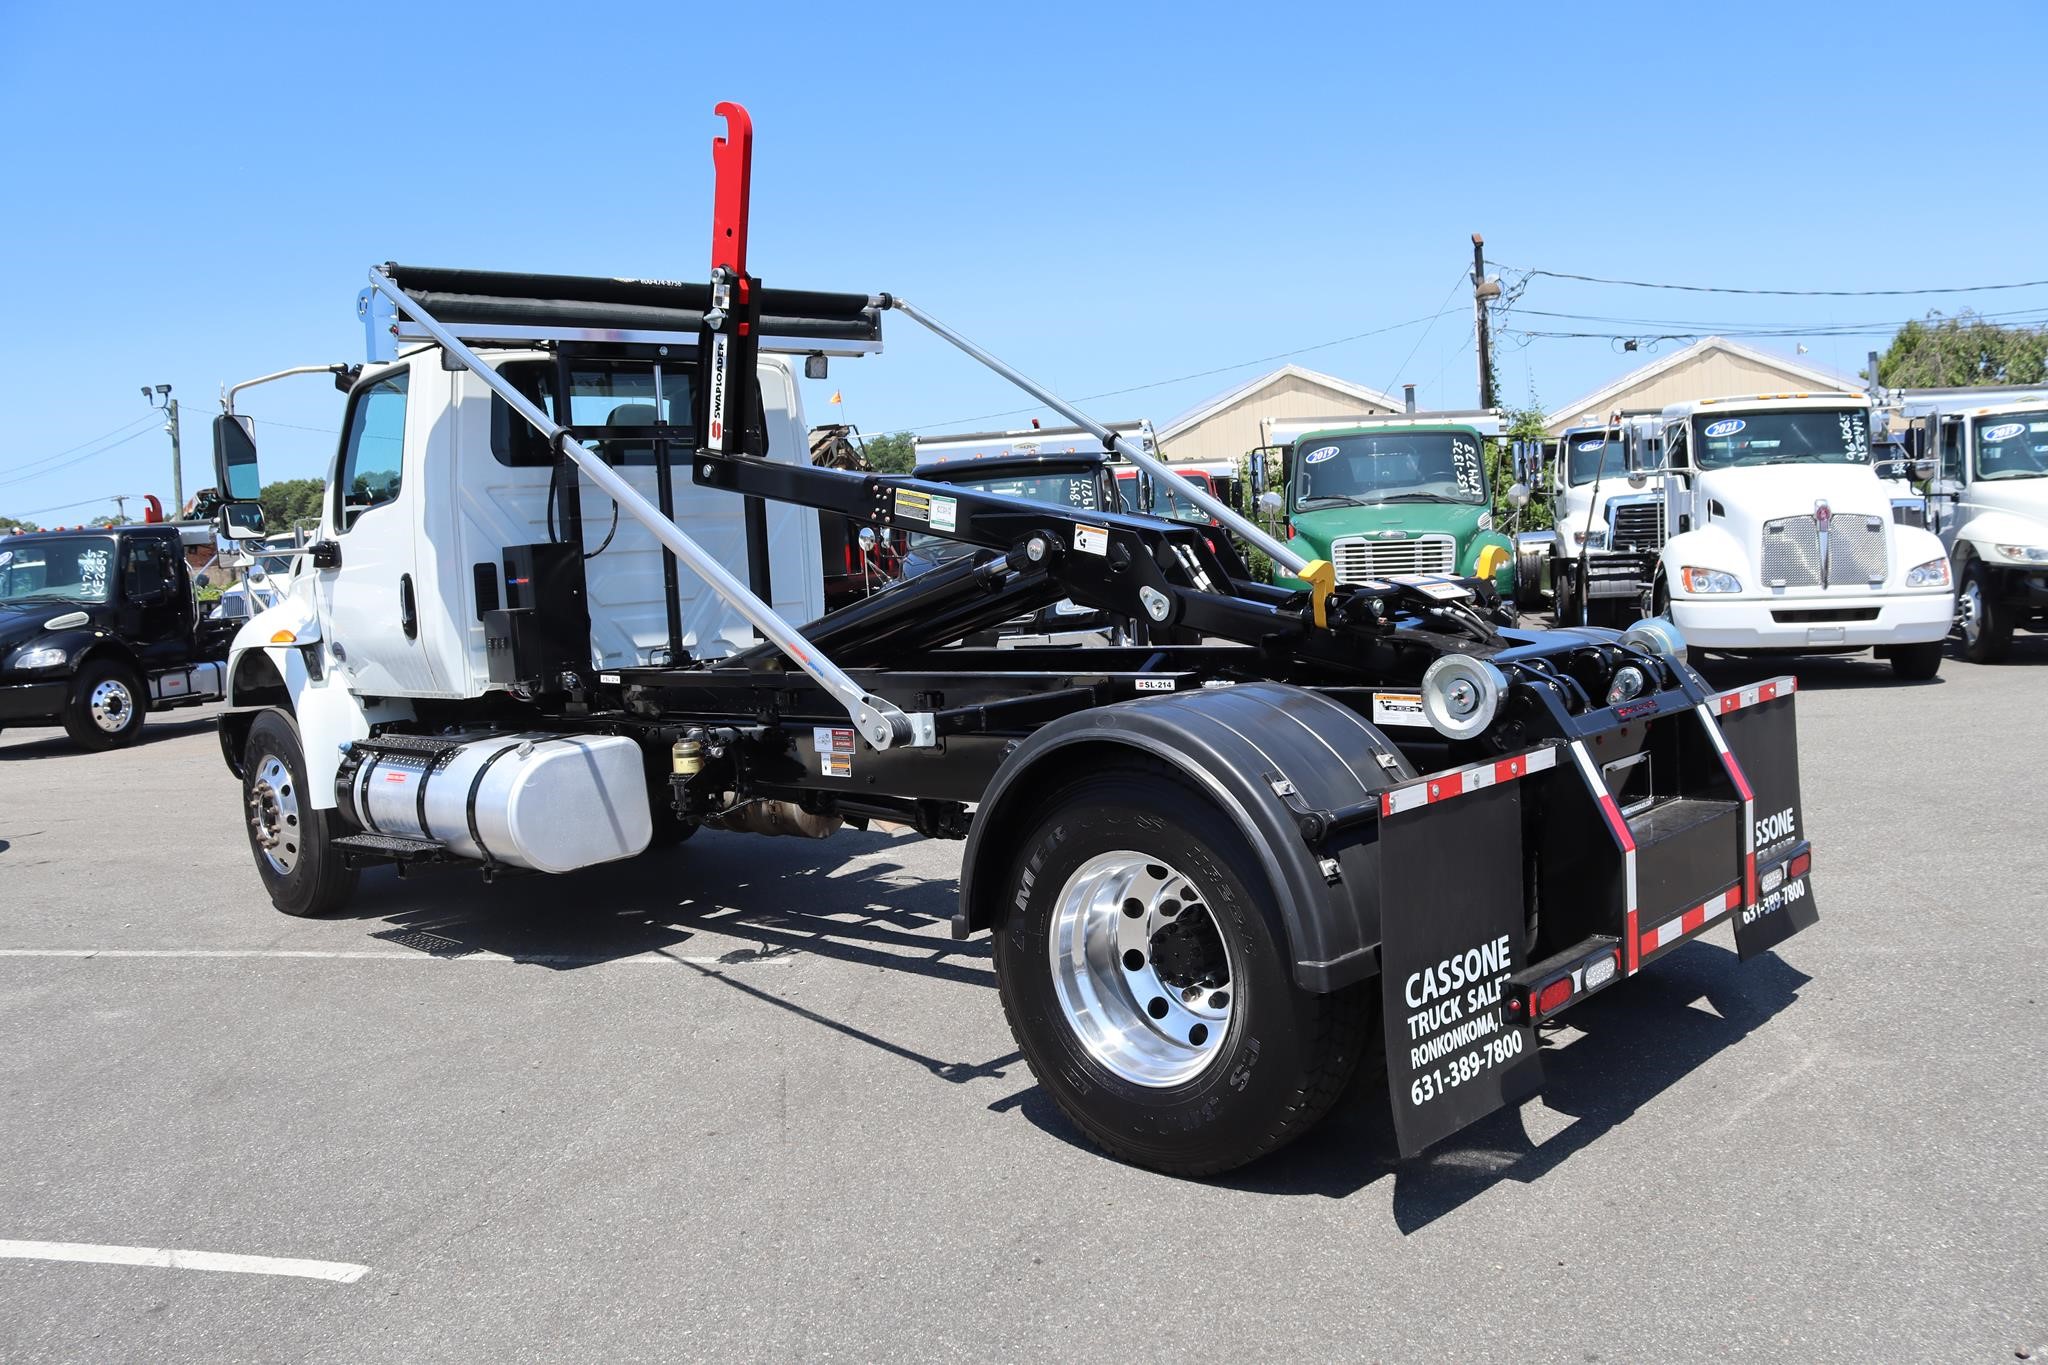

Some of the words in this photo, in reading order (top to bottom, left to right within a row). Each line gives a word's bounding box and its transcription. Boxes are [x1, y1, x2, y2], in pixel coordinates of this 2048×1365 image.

[714, 342, 724, 419] SWAPLOADER
[1713, 420, 1739, 435] 2021
[1994, 424, 2019, 439] 2019
[1312, 448, 1334, 462] 2019
[1453, 438, 1470, 495] 155-1375
[1463, 443, 1483, 496] KM4773
[92, 550, 108, 596] KE2684
[1144, 681, 1172, 689] SL-214
[1742, 878, 1805, 925] 631-389-7800
[1405, 934, 1511, 1009] CASSONE
[1407, 995, 1463, 1040] TRUCK
[1410, 1012, 1499, 1070] RONKONKOMA,
[1411, 1029, 1523, 1106] 631-389-7800
